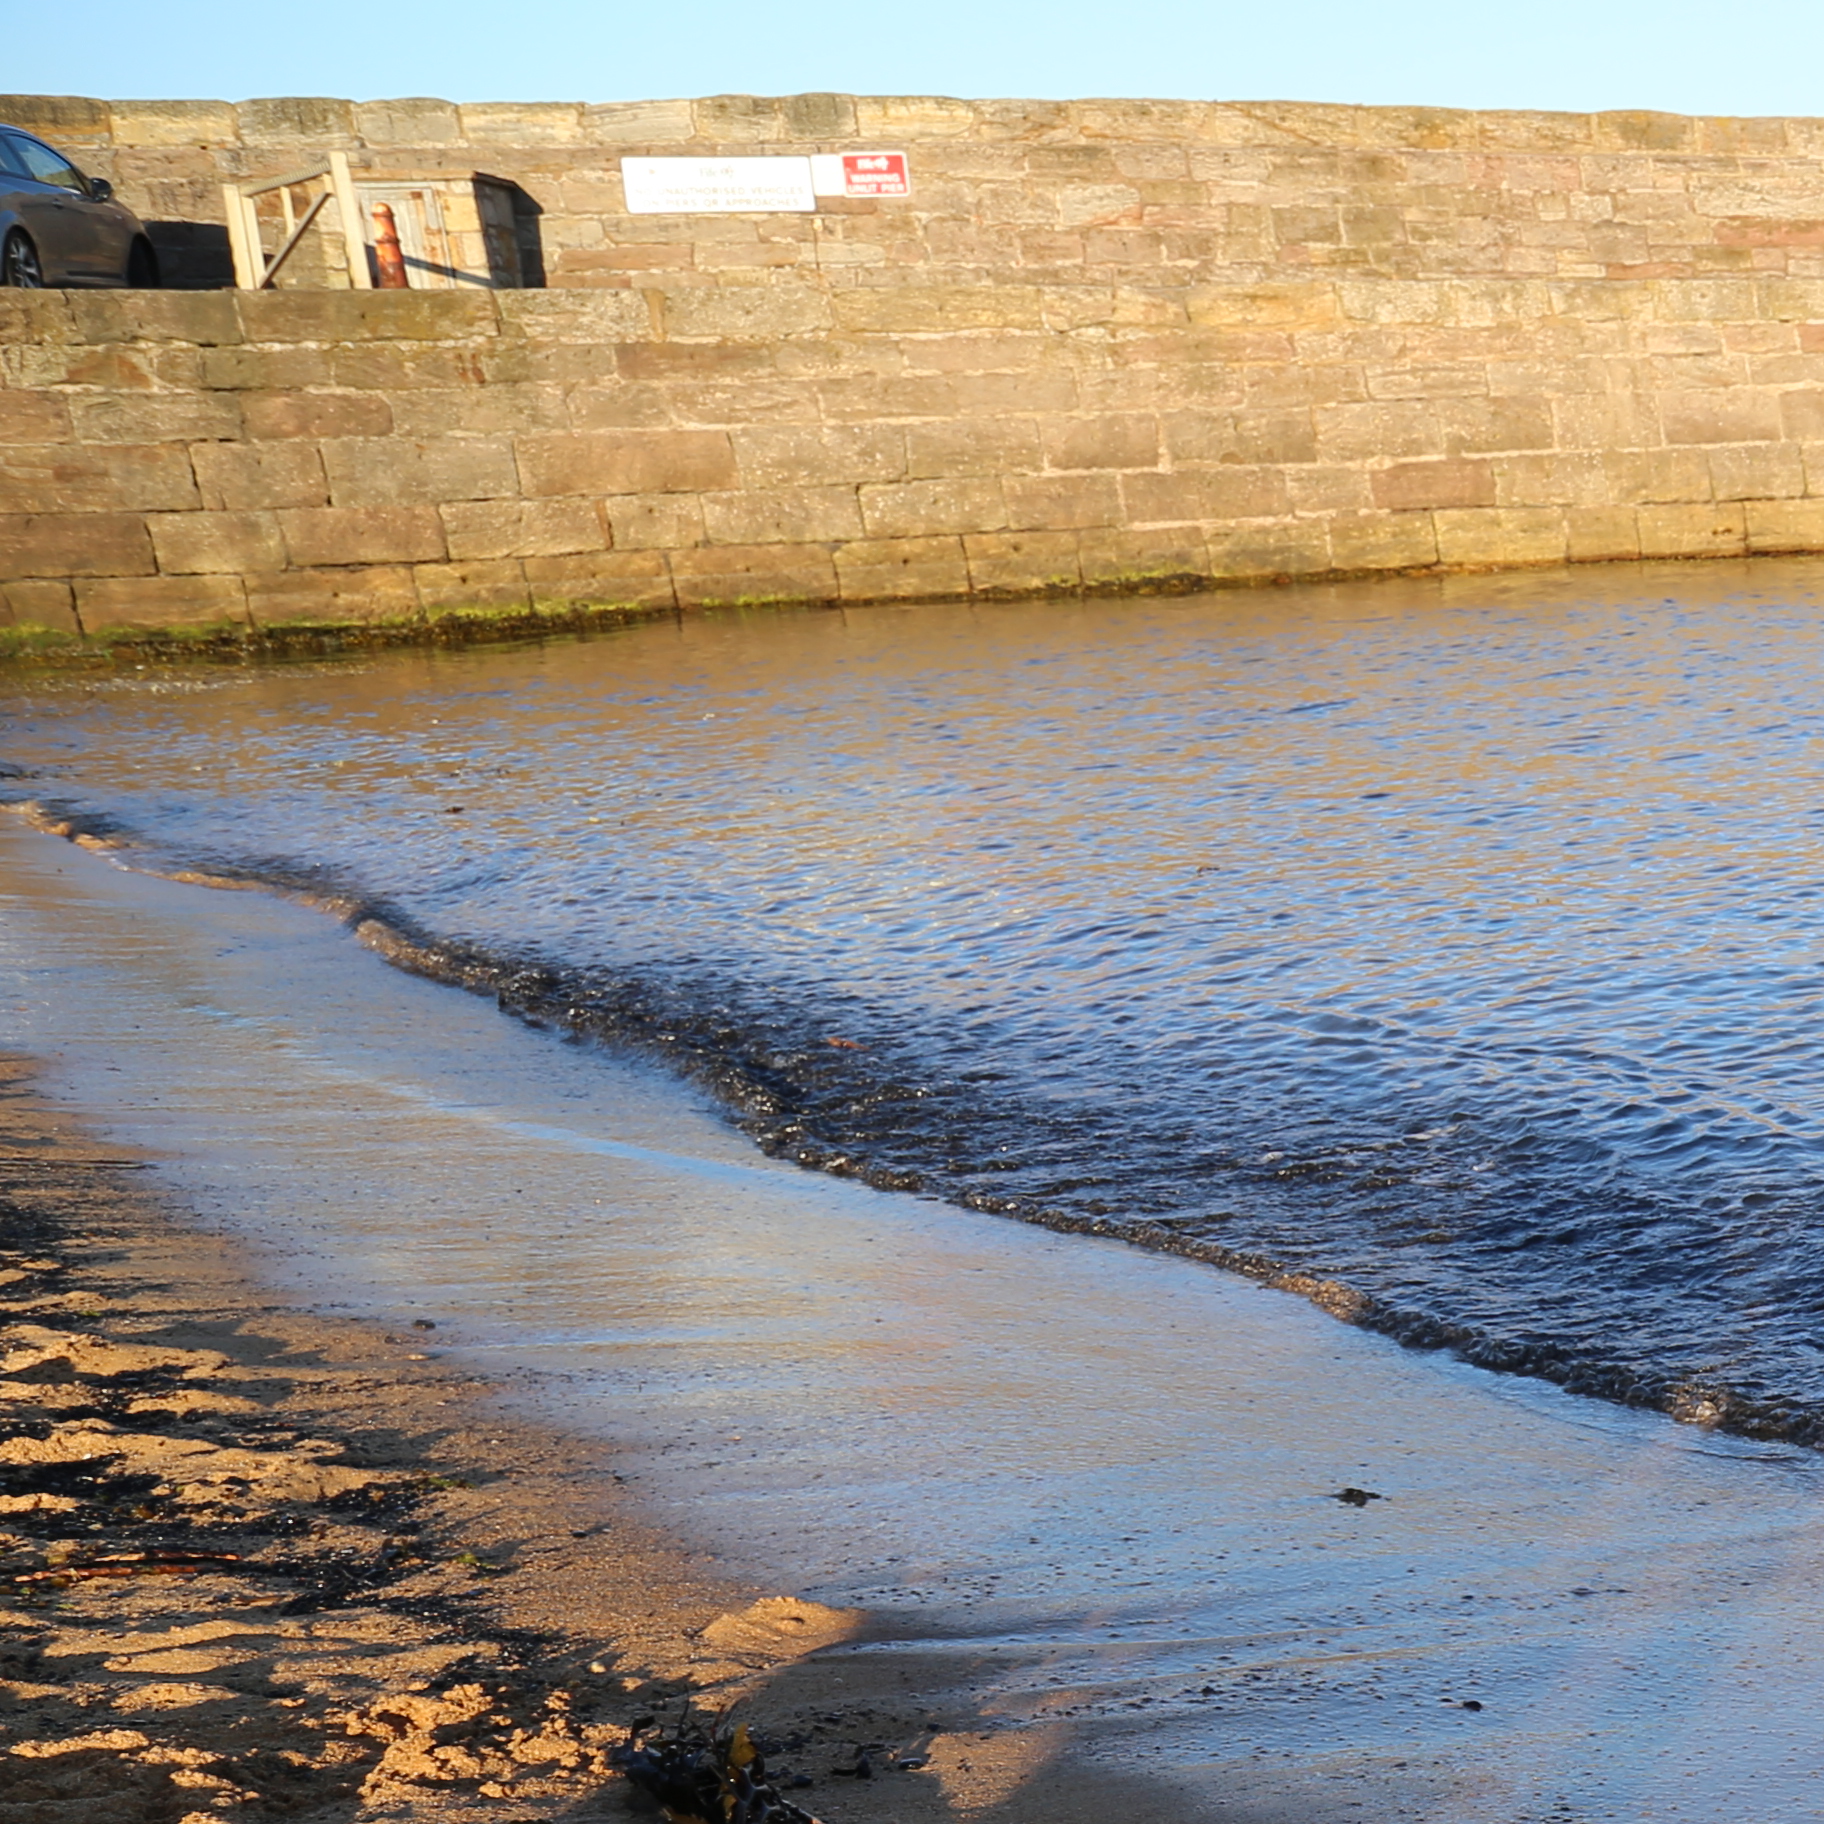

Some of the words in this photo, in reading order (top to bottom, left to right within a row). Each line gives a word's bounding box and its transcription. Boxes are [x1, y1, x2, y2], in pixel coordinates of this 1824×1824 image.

[850, 173, 901, 183] WARNING
[751, 186, 804, 195] VEHICLES
[881, 183, 905, 193] PIER
[725, 198, 799, 206] APPROACHES
